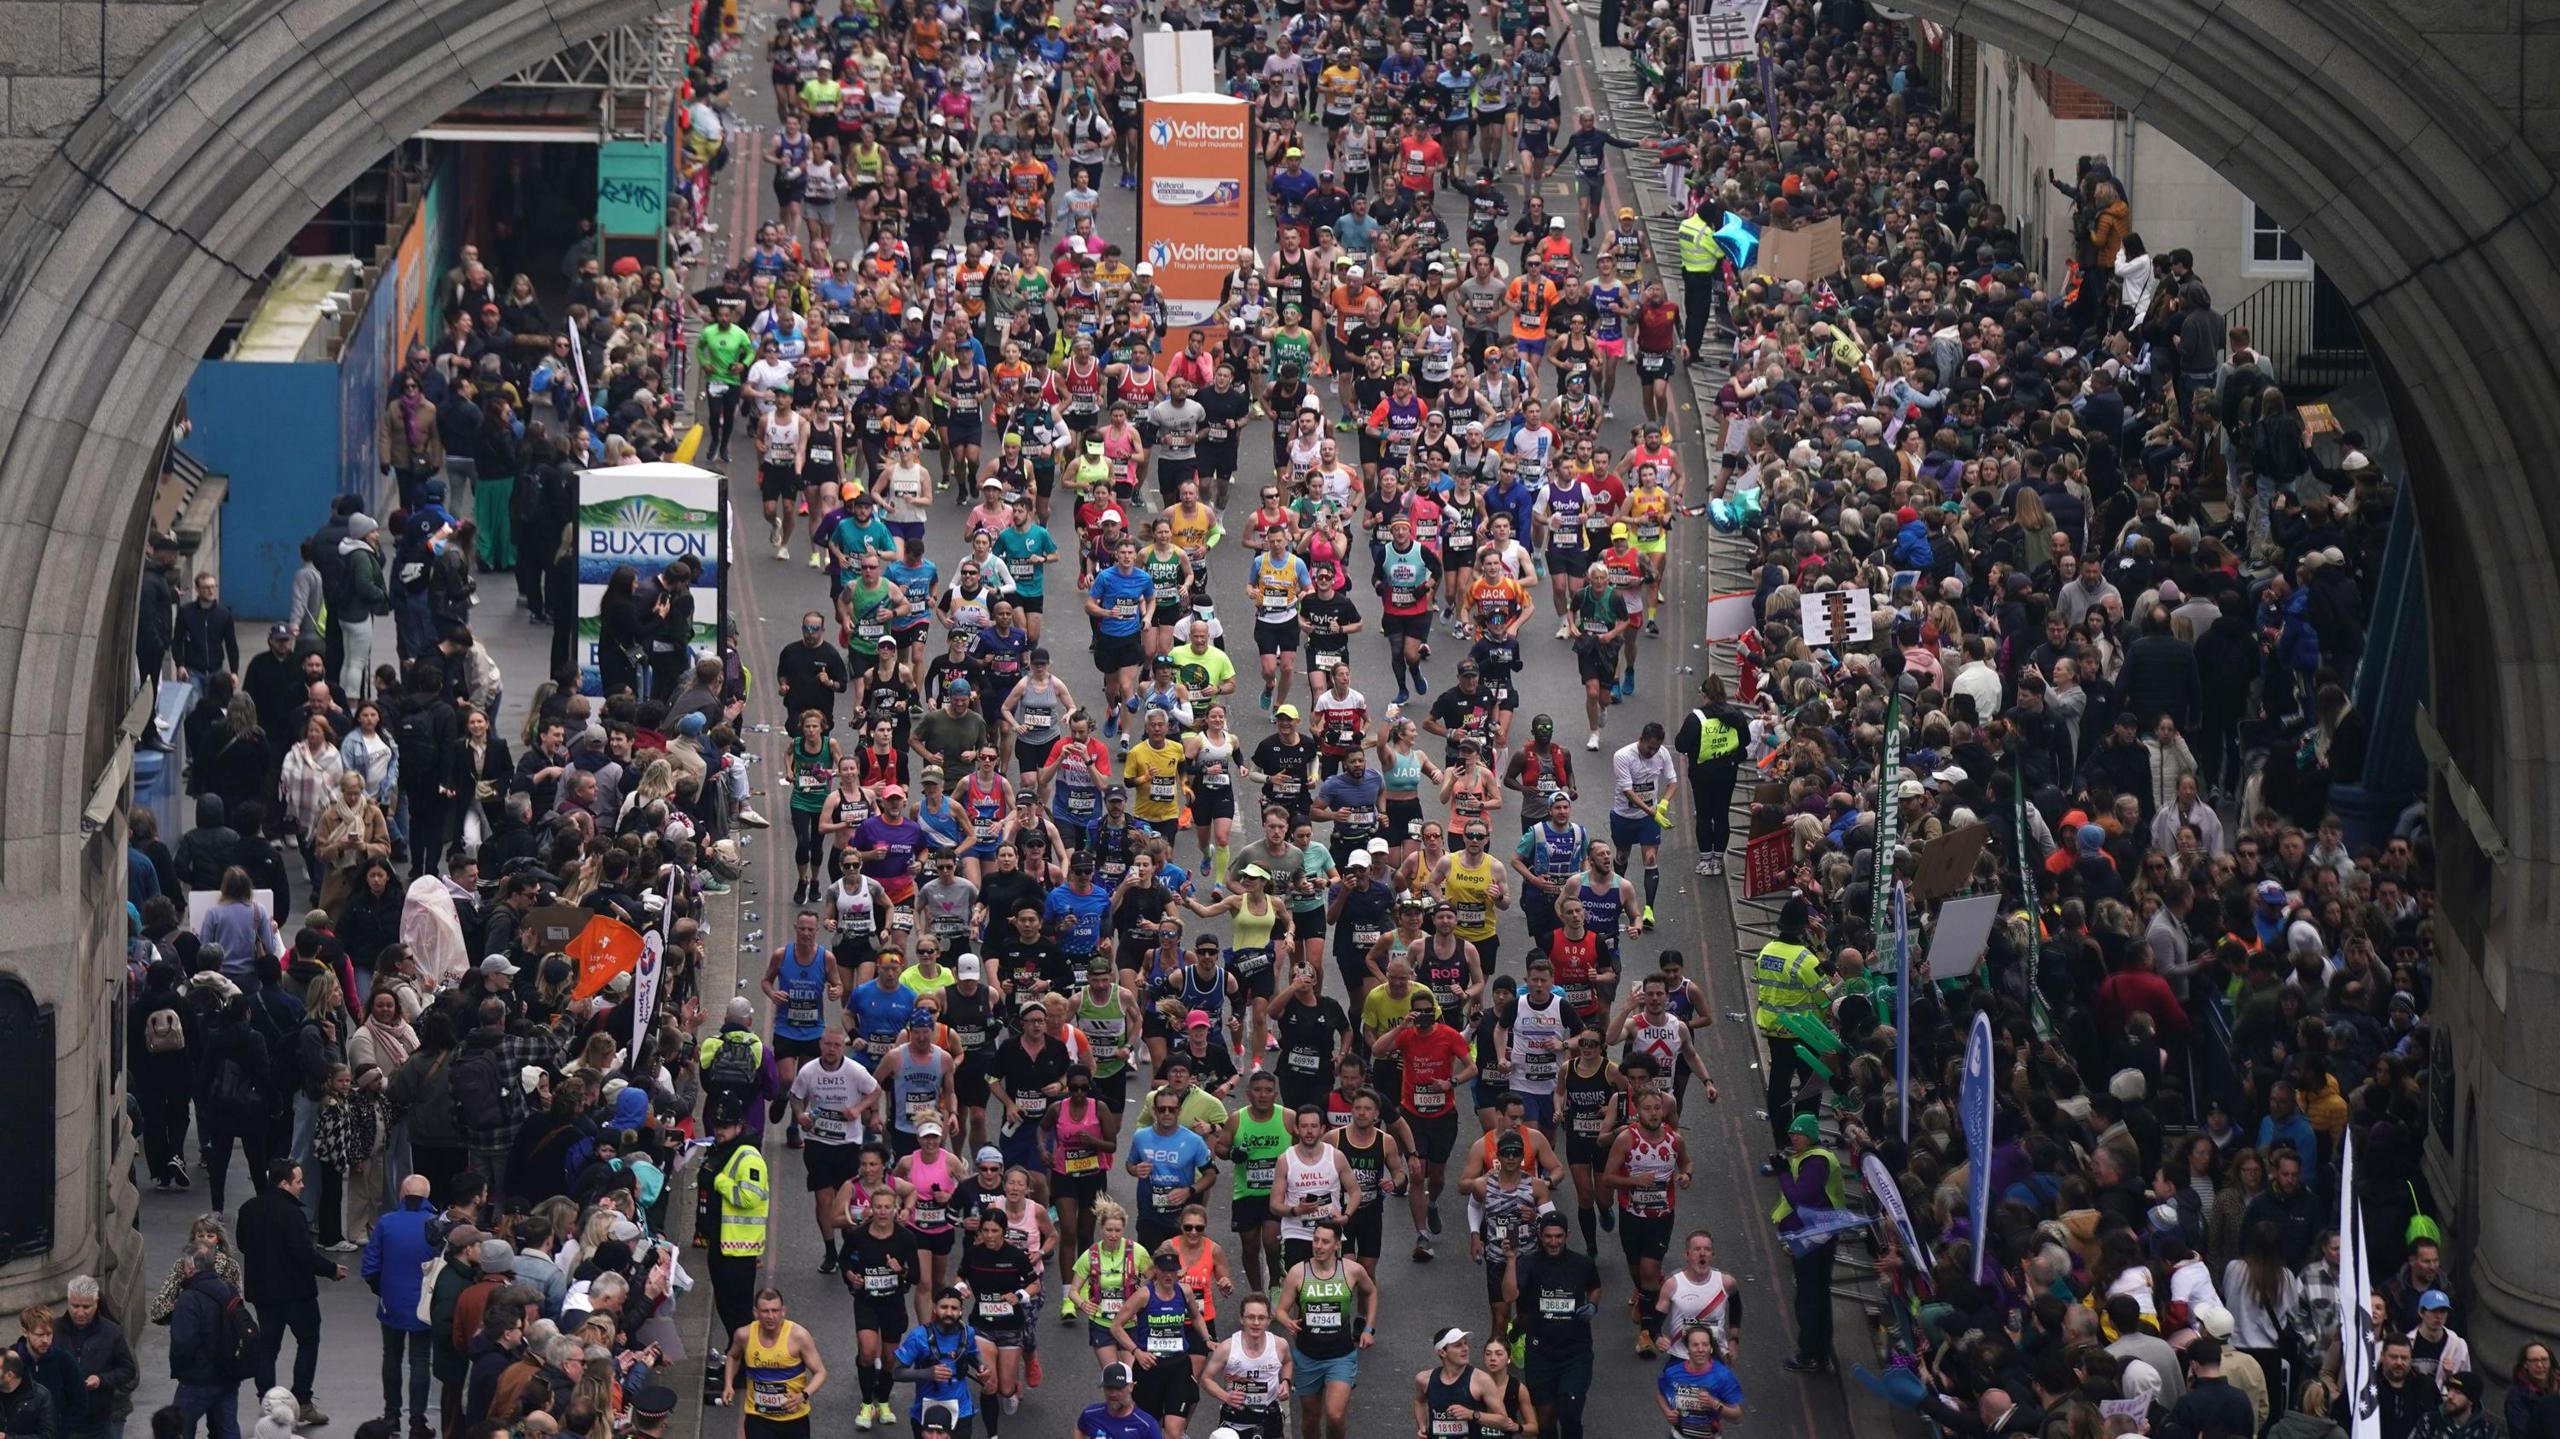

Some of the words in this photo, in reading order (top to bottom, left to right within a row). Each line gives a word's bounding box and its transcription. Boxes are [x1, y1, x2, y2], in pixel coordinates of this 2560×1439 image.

[1171, 120, 1243, 139] Voltarol
[1618, 235, 1638, 244] DREW
[1836, 344, 1850, 358] Go
[1126, 392, 1149, 400] ITALIA
[1391, 414, 1416, 425] Stroke
[1552, 499, 1580, 510] Stroke
[591, 530, 706, 557] BUXTON
[1149, 563, 1178, 572] JENNY
[1480, 589, 1505, 599] JACK
[1393, 767, 1420, 778] JADE
[1883, 728, 1900, 865] RUNNERS
[1871, 849, 1881, 887] London
[1456, 872, 1485, 884] Meego
[1582, 900, 1617, 909] CONNOR
[1354, 923, 1366, 931] tcs
[1563, 946, 1586, 956] ROB
[1430, 968, 1460, 979] ROB
[788, 989, 815, 1000] RICKY
[1643, 1028, 1675, 1040] HUGH
[817, 1076, 844, 1085] LEWIS
[907, 1092, 919, 1101] tcs
[1569, 1091, 1606, 1102] VERSUS
[1066, 1149, 1078, 1158] tcs
[1299, 1173, 1323, 1181] WILL
[865, 1266, 878, 1275] tcs
[1306, 1282, 1343, 1297] ALEX
[1541, 1289, 1554, 1298] tcs
[980, 1292, 992, 1301] tcs
[1307, 1303, 1320, 1312] tcs
[1311, 1314, 1335, 1324] 47941
[1148, 1327, 1162, 1336] tcs
[1432, 1409, 1446, 1419] tcs
[1437, 1423, 1462, 1433] 18189
